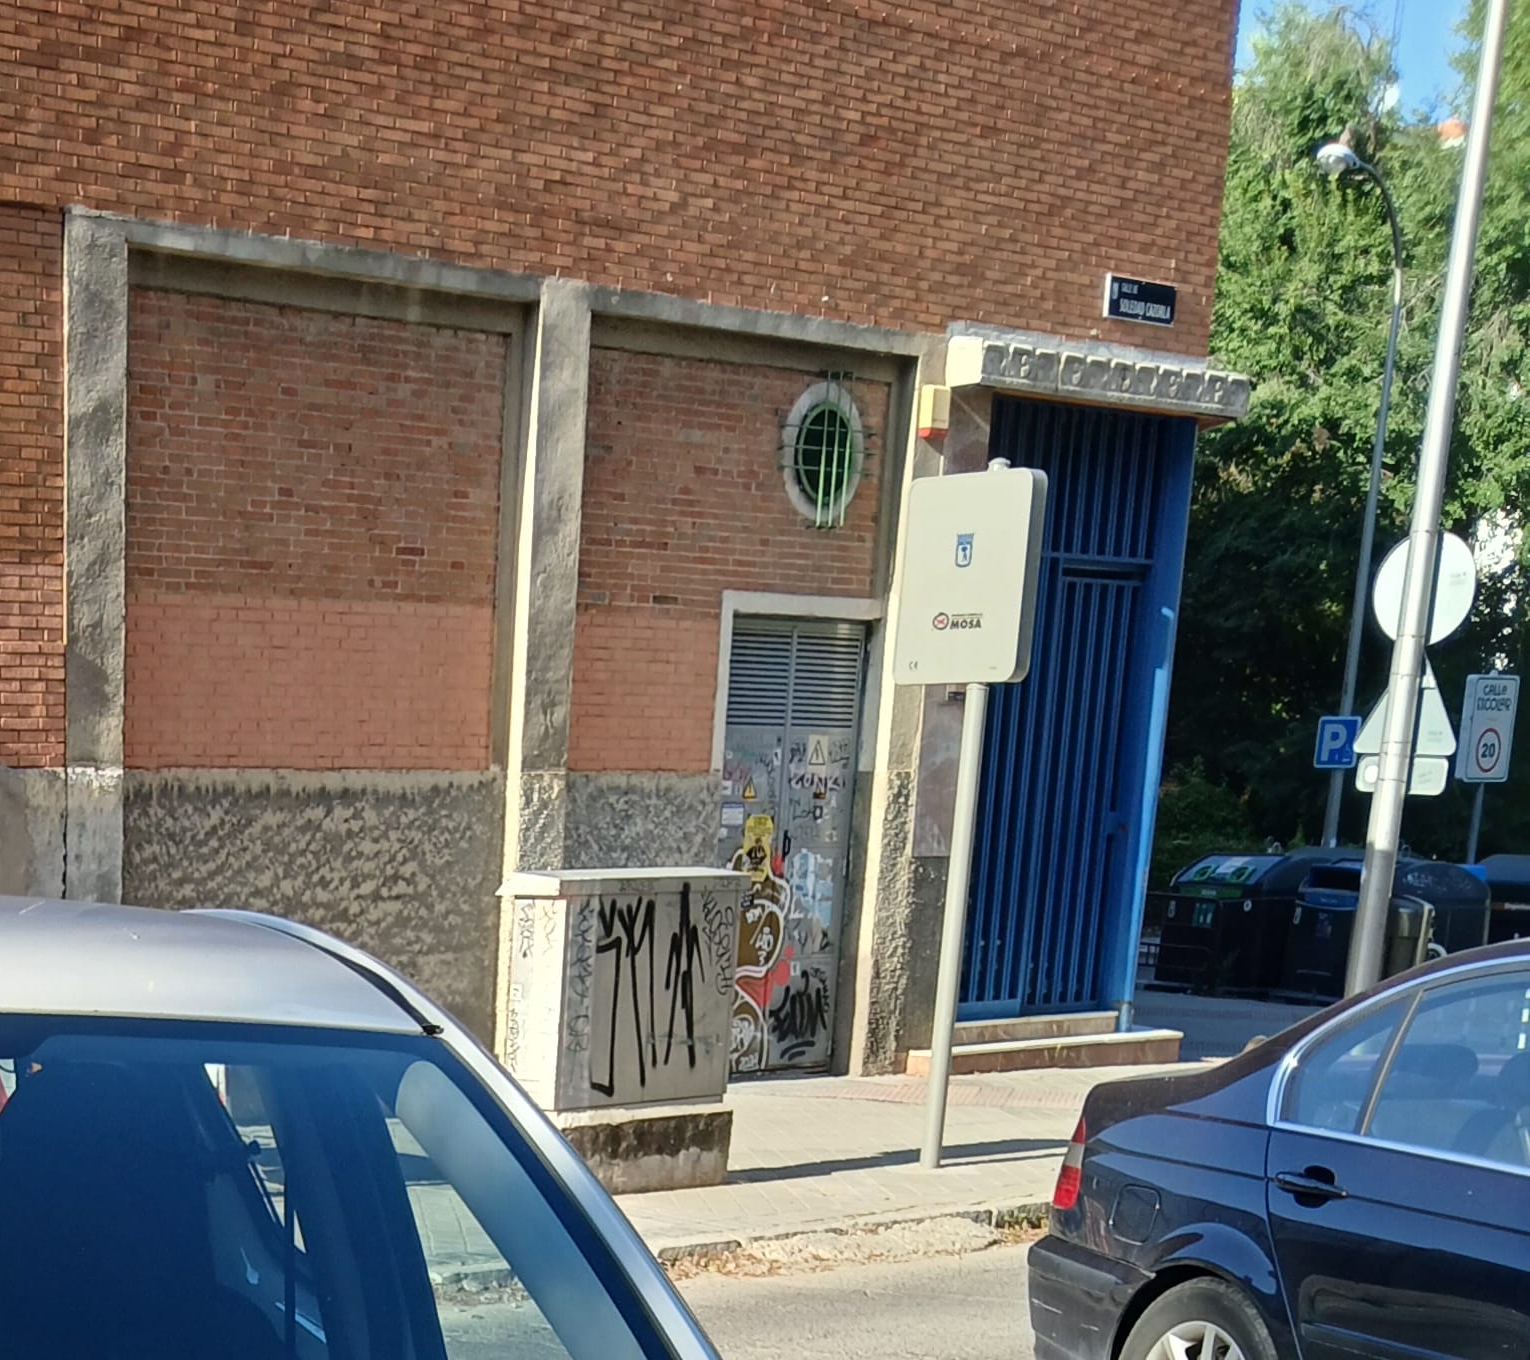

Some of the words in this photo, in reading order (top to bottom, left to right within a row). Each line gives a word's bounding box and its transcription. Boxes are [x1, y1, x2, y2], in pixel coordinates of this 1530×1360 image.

[1119, 298, 1145, 315] SOLEDAD
[950, 618, 982, 629] MOSA
[1321, 724, 1347, 761] P
[1481, 743, 1496, 758] 20
